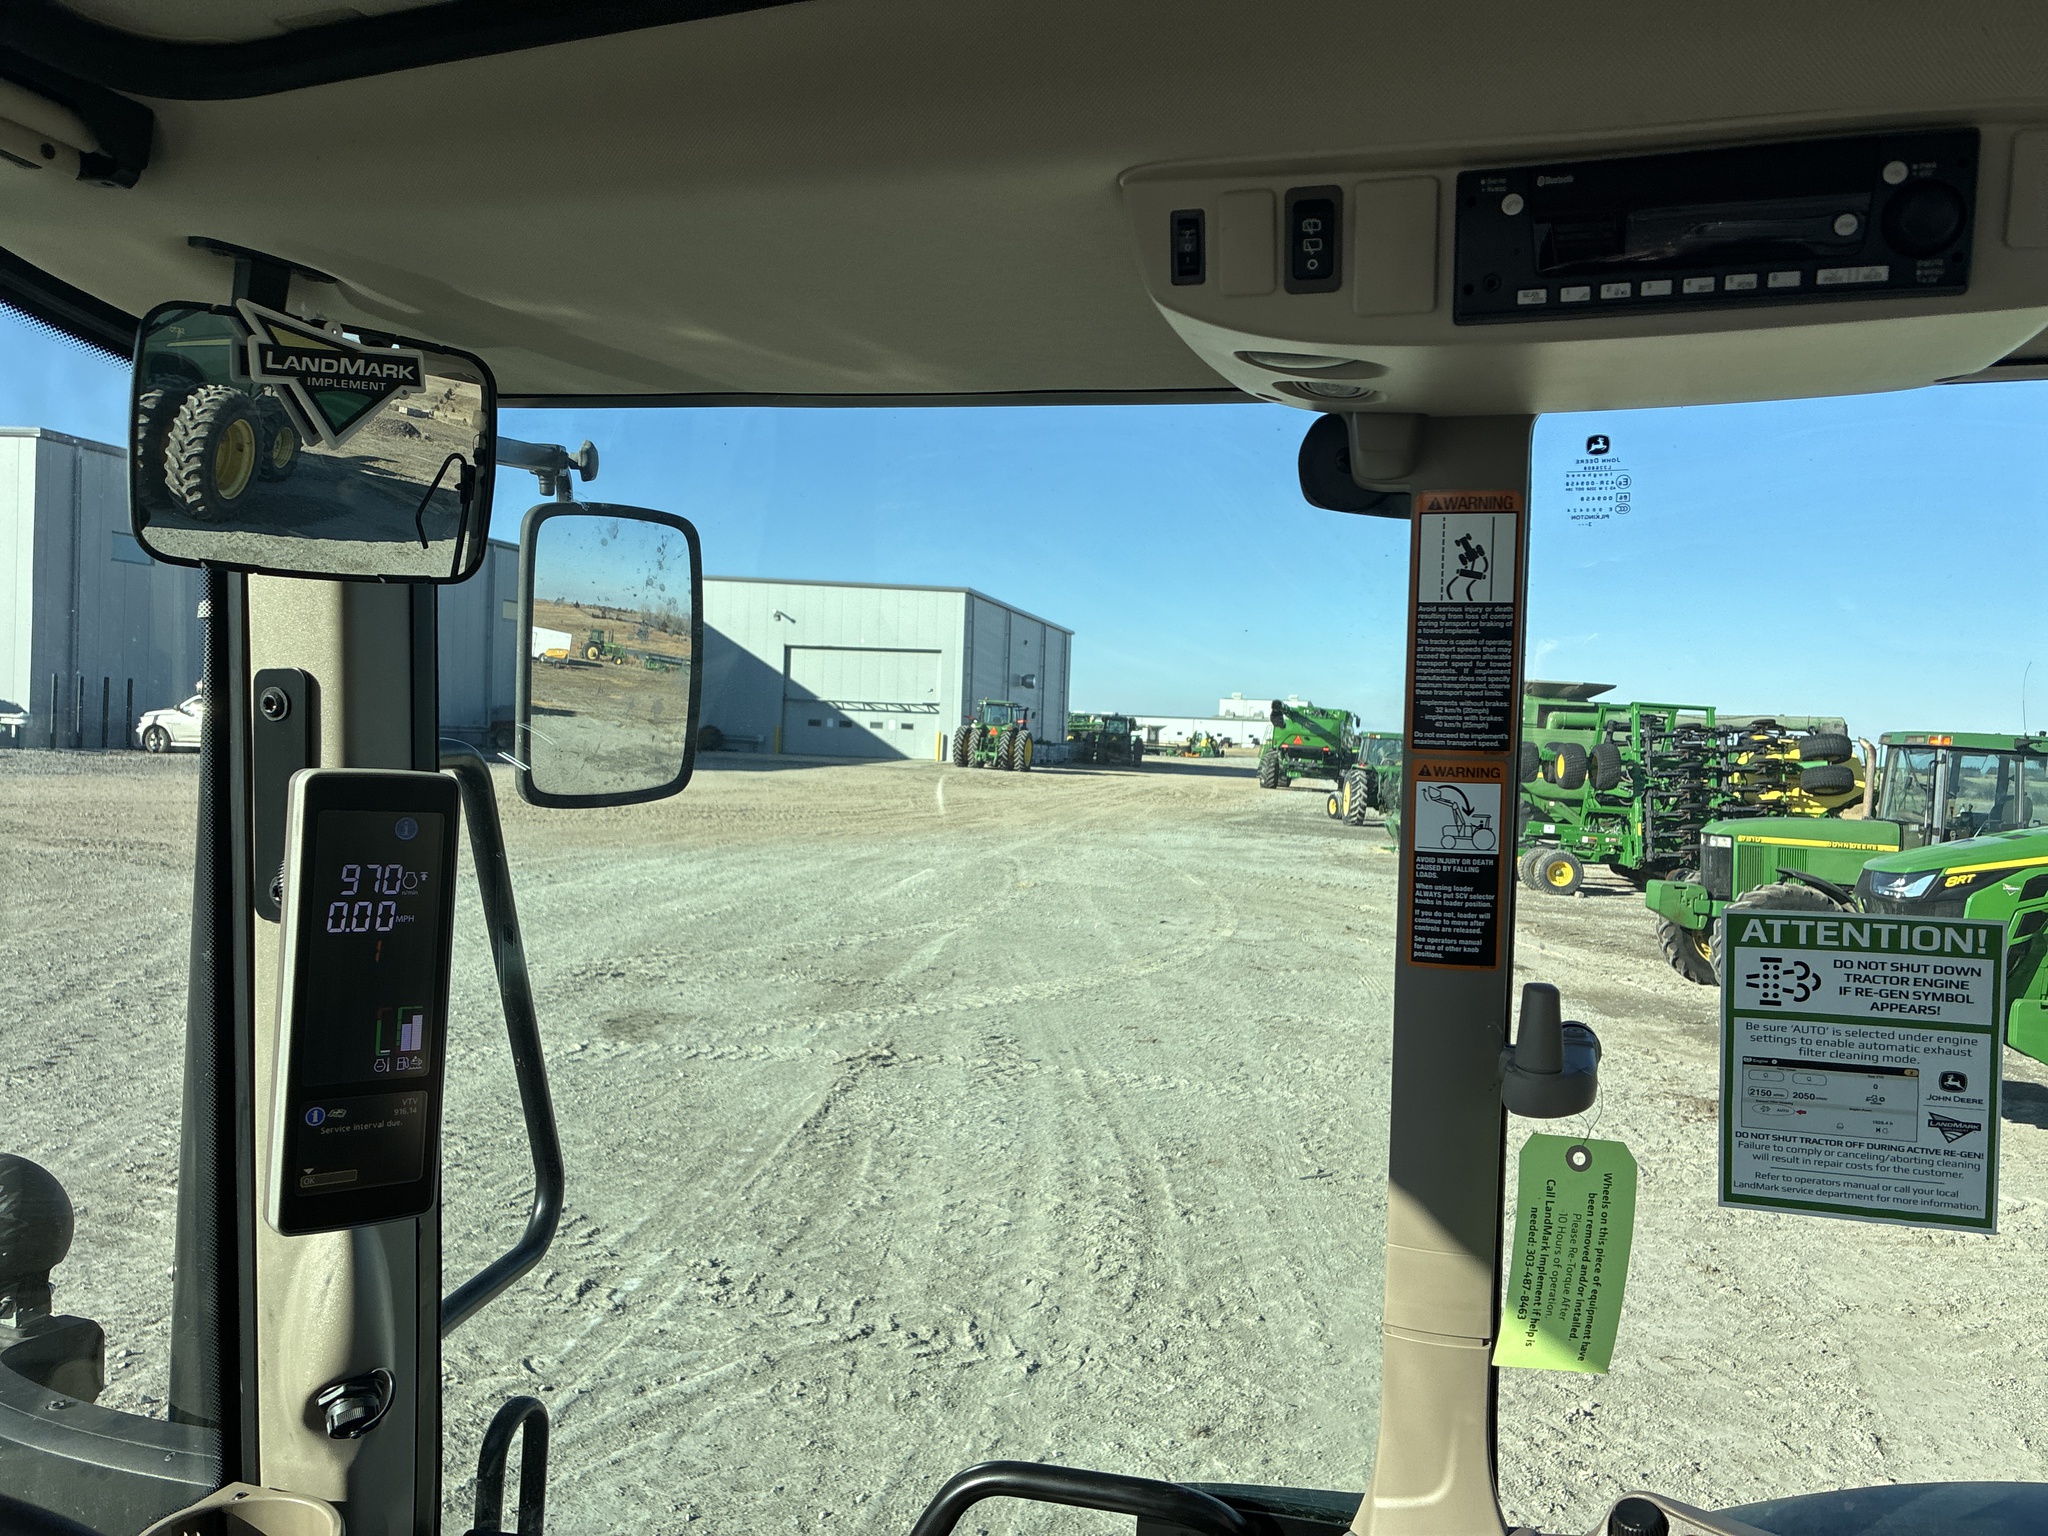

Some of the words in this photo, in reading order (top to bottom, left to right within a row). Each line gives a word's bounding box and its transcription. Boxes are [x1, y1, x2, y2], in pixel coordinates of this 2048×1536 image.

[266, 351, 414, 380] LANDMARK
[307, 377, 386, 391] IMPLEMENT
[1443, 496, 1513, 510] WARNING
[1433, 766, 1500, 778] WARNING
[341, 864, 403, 895] 970
[1945, 874, 1976, 887] 8RT
[327, 901, 396, 932] 0.00
[1741, 919, 1987, 954] ATTENTION!
[1833, 959, 1854, 969] DO
[1857, 960, 1887, 971] NOT
[1890, 962, 1930, 973] SHUT
[1933, 964, 1981, 977] DOWN
[1843, 973, 1910, 986] TRACTOR
[1913, 977, 1969, 990] ENGINE
[1839, 986, 1851, 995] IF
[1854, 987, 1909, 999] RE-GEN
[1912, 990, 1974, 1004] SYMBOL
[1869, 1001, 1941, 1015] APPEARS!
[1745, 1021, 1760, 1031] Be
[1762, 1024, 1787, 1032] sure
[1832, 1027, 1842, 1036] is
[1844, 1028, 1895, 1040] selected
[1898, 1032, 1933, 1042] under
[1936, 1036, 1978, 1047] engine
[1750, 1033, 1797, 1045] settings
[1800, 1036, 1812, 1045] to
[1815, 1038, 1855, 1048] enable
[1858, 1042, 1920, 1053] automatic
[1923, 1045, 1972, 1057] exhaust
[1798, 1047, 1829, 1058] filter
[1829, 1049, 1879, 1064] cleaning
[1882, 1054, 1920, 1064] mode.
[1749, 1088, 1772, 1097] 2150
[1792, 1091, 1815, 1100] 2050
[1926, 1093, 1951, 1101] JOHN
[1953, 1095, 1983, 1104] DEERE
[321, 1126, 350, 1134] Service
[354, 1121, 384, 1130] interval
[1735, 1130, 1749, 1138] DO
[1750, 1132, 1771, 1140] NOT
[1771, 1134, 1798, 1143] SHUT
[1798, 1136, 1843, 1147] TRACTOR
[1845, 1140, 1865, 1149] OFF
[1866, 1142, 1905, 1152] DURING
[1906, 1146, 1941, 1156] ACTIVE
[1943, 1149, 1984, 1159] RE-GEN!
[1738, 1140, 1770, 1151] Failure
[1772, 1144, 1783, 1152] to
[1785, 1146, 1822, 1157] comply
[1836, 1151, 1934, 1168] canceling/aborting
[1936, 1158, 1980, 1172] cleaning
[1752, 1153, 1769, 1161] will
[1771, 1155, 1800, 1164] result
[1802, 1157, 1811, 1165] in
[1813, 1159, 1843, 1168] repair
[1845, 1162, 1873, 1171] costs
[1875, 1163, 1891, 1172] for
[1892, 1164, 1910, 1174] the
[1912, 1168, 1964, 1179] customer.
[1546, 1179, 1556, 1198] Call
[1601, 1173, 1612, 1209] Wheels
[1733, 1180, 1779, 1193] LandMark
[1781, 1186, 1814, 1195] service
[1815, 1188, 1874, 1201] department
[1876, 1193, 1890, 1202] for
[1892, 1197, 1918, 1205] more
[1920, 1198, 1981, 1211] information.
[1755, 1171, 1780, 1181] Refer
[1781, 1174, 1792, 1182] to
[1794, 1176, 1841, 1187] operators
[1843, 1181, 1880, 1190] manual
[1894, 1185, 1910, 1193] call
[1912, 1186, 1934, 1197] your
[1936, 1188, 1959, 1198] local
[1587, 1193, 1597, 1217] been
[1528, 1207, 1538, 1246] needed:
[1541, 1201, 1555, 1251] LandMark
[1558, 1214, 1568, 1223] 10
[1570, 1214, 1581, 1244] Please
[1600, 1212, 1608, 1224] on
[1555, 1226, 1566, 1254] Hours
[1582, 1220, 1593, 1263] removed
[1598, 1228, 1608, 1245] this
[1553, 1258, 1562, 1268] of
[1563, 1247, 1578, 1295] Re-Torque
[1594, 1248, 1605, 1273] piece
[1517, 1250, 1536, 1319] 303-487-8463
[1533, 1254, 1549, 1306] Implement
[1577, 1264, 1588, 1296] and/or
[1593, 1277, 1601, 1287] of
[1545, 1271, 1558, 1318] operation,
[1559, 1297, 1570, 1320] After
[1568, 1299, 1584, 1341] installed.
[1583, 1289, 1598, 1340] equipment
[1526, 1318, 1540, 1337] help
[1577, 1342, 1591, 1361] have
